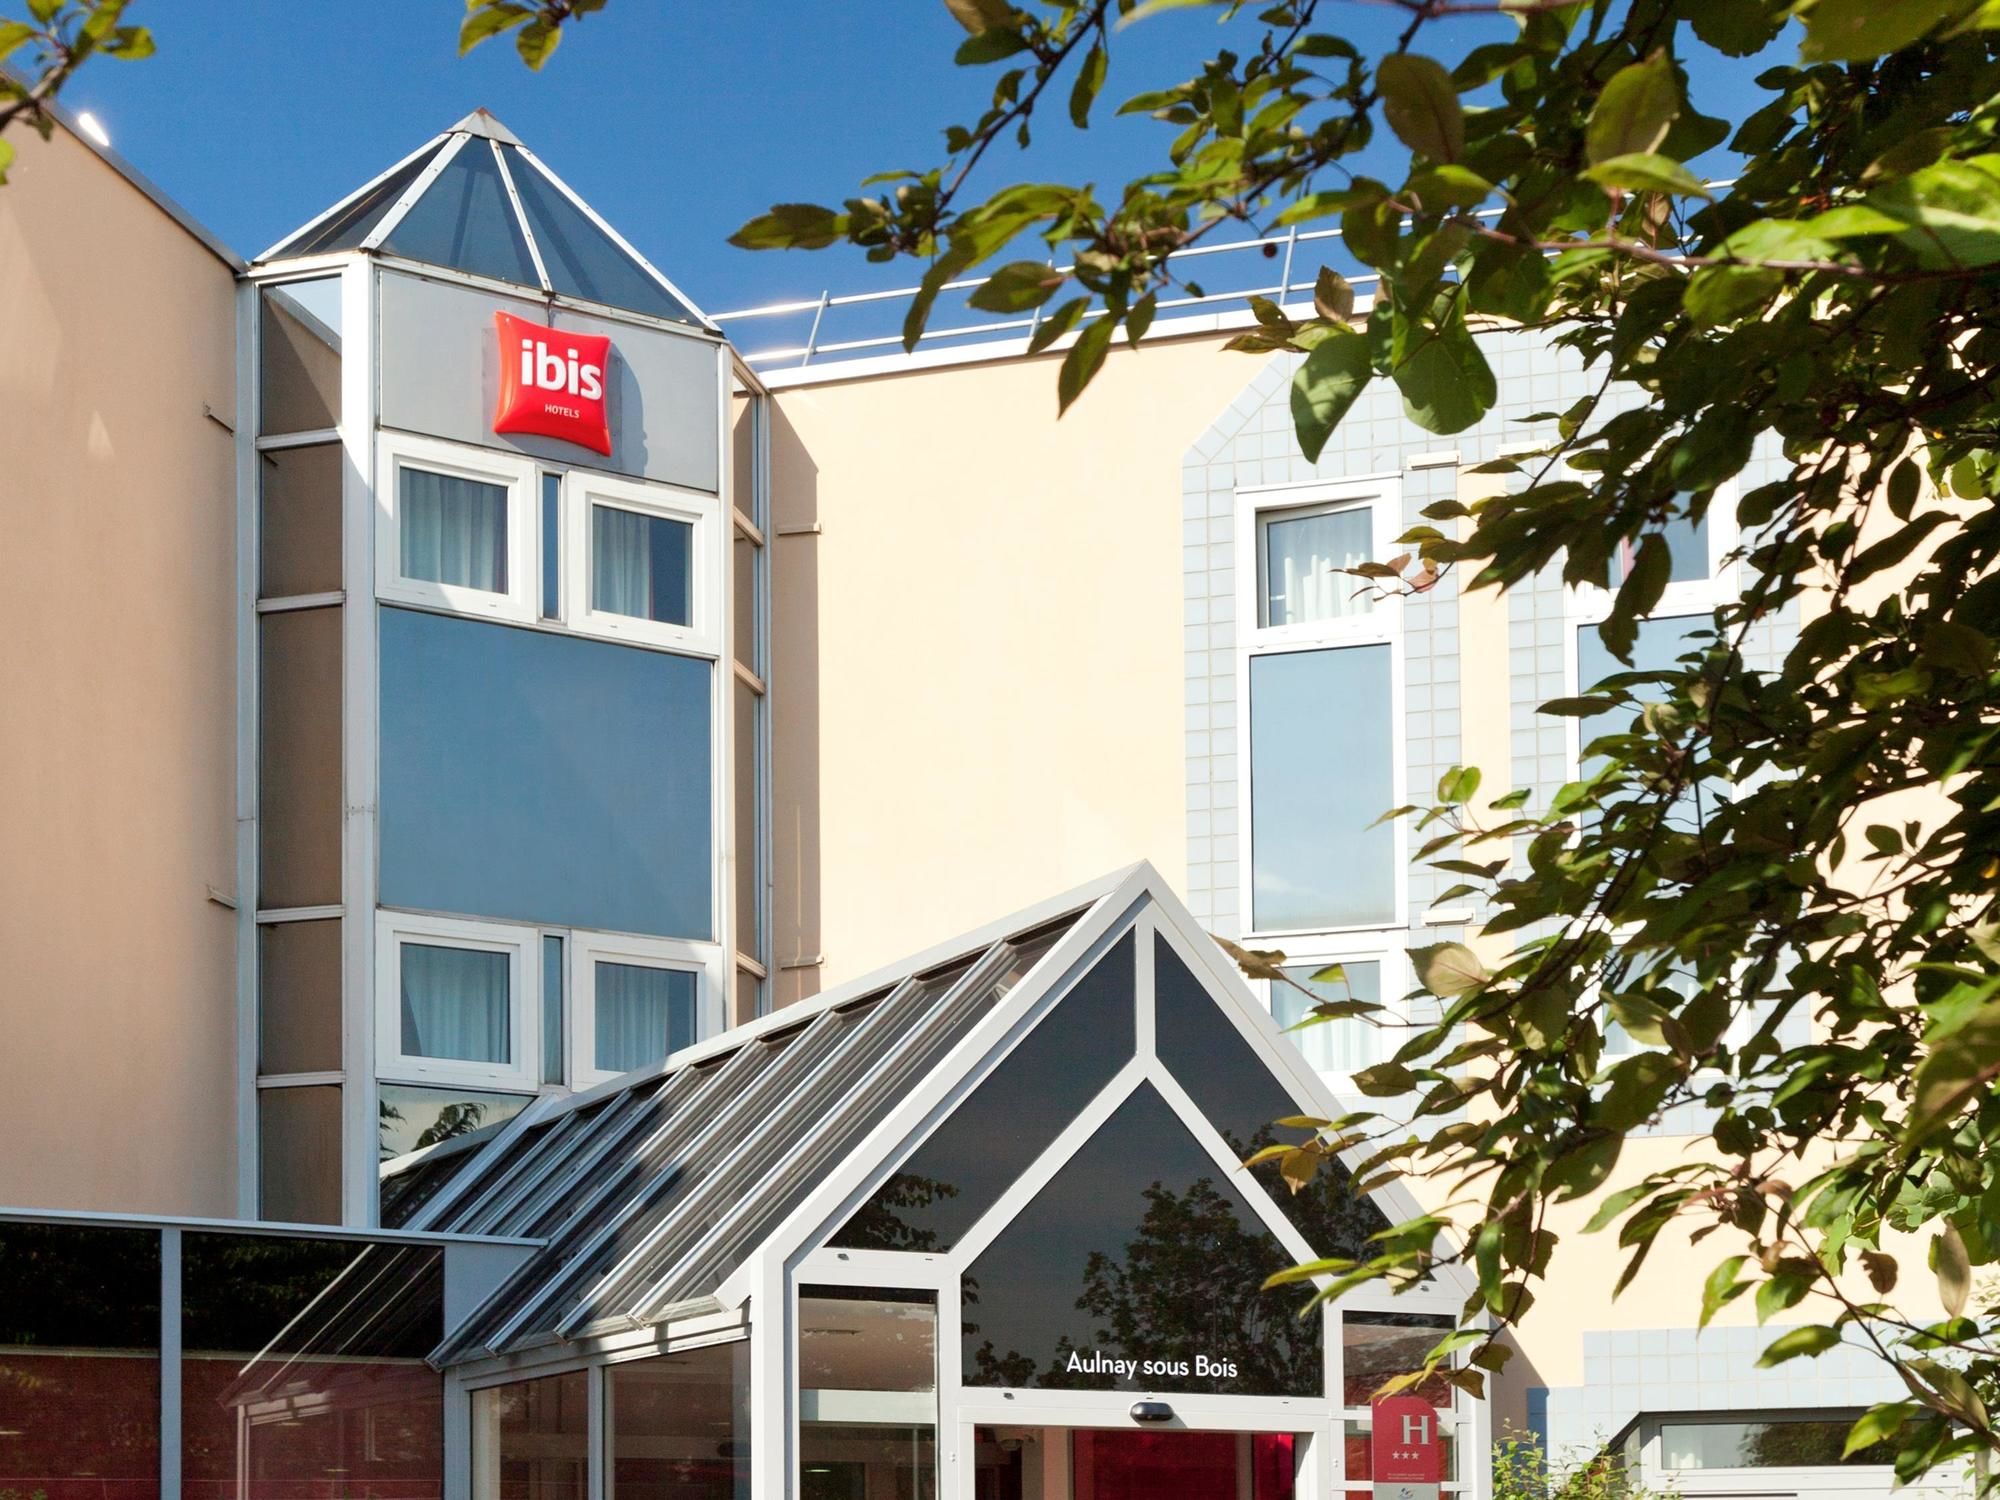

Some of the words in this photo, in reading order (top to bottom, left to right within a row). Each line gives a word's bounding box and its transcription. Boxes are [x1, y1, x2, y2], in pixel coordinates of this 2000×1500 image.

[521, 339, 602, 400] ibis
[544, 403, 580, 418] HOTELS
[1066, 1350, 1137, 1380] Aulnay
[1143, 1360, 1189, 1376] sous
[1195, 1355, 1238, 1378] Bois
[1401, 1414, 1430, 1445] H
